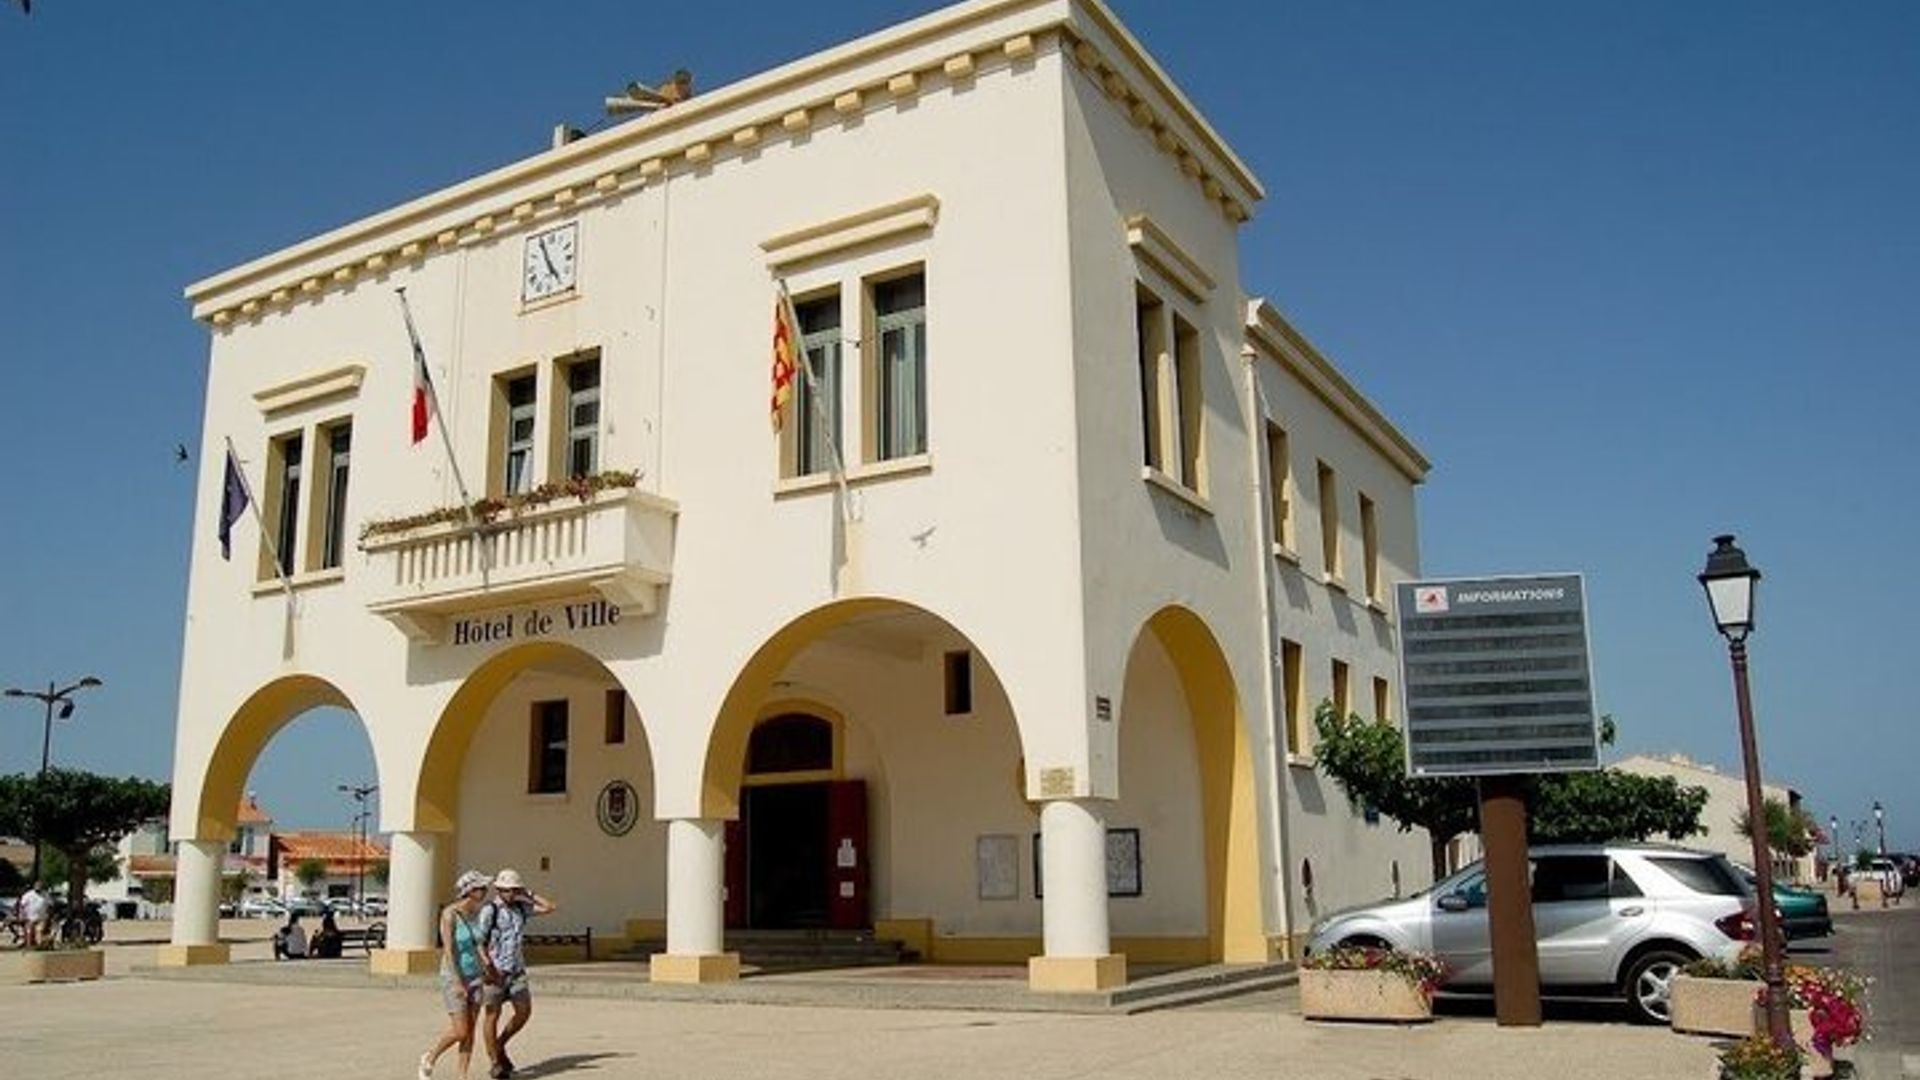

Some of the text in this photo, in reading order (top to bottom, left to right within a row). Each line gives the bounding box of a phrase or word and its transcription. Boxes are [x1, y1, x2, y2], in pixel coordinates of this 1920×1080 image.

[1457, 588, 1564, 603] INFORMATIONS
[455, 601, 620, 644] Hôtel de Ville
